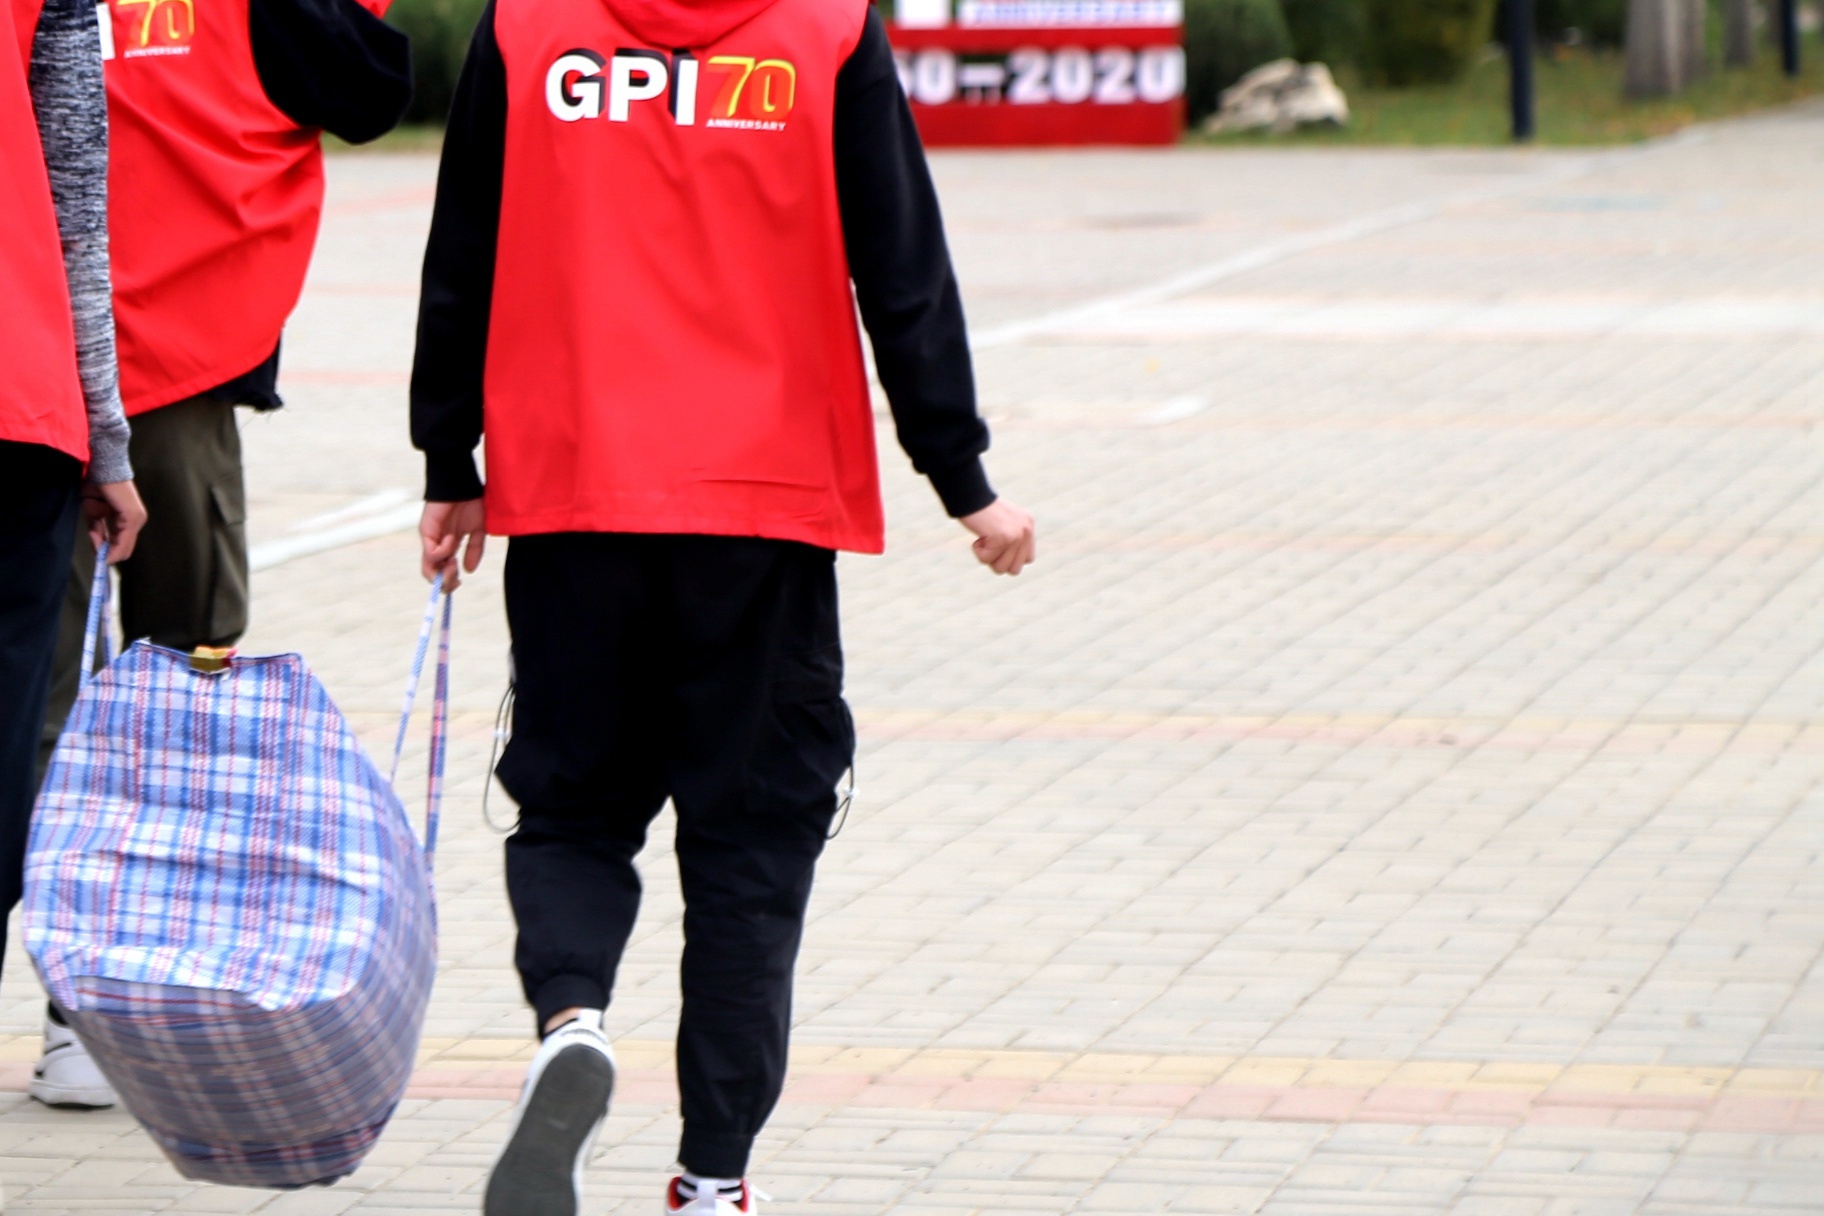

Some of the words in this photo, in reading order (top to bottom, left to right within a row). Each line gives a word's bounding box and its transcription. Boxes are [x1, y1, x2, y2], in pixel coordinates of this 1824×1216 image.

[545, 47, 699, 126] GPI
[705, 55, 796, 119] 70
[705, 117, 787, 132] ANNIVERSARY
